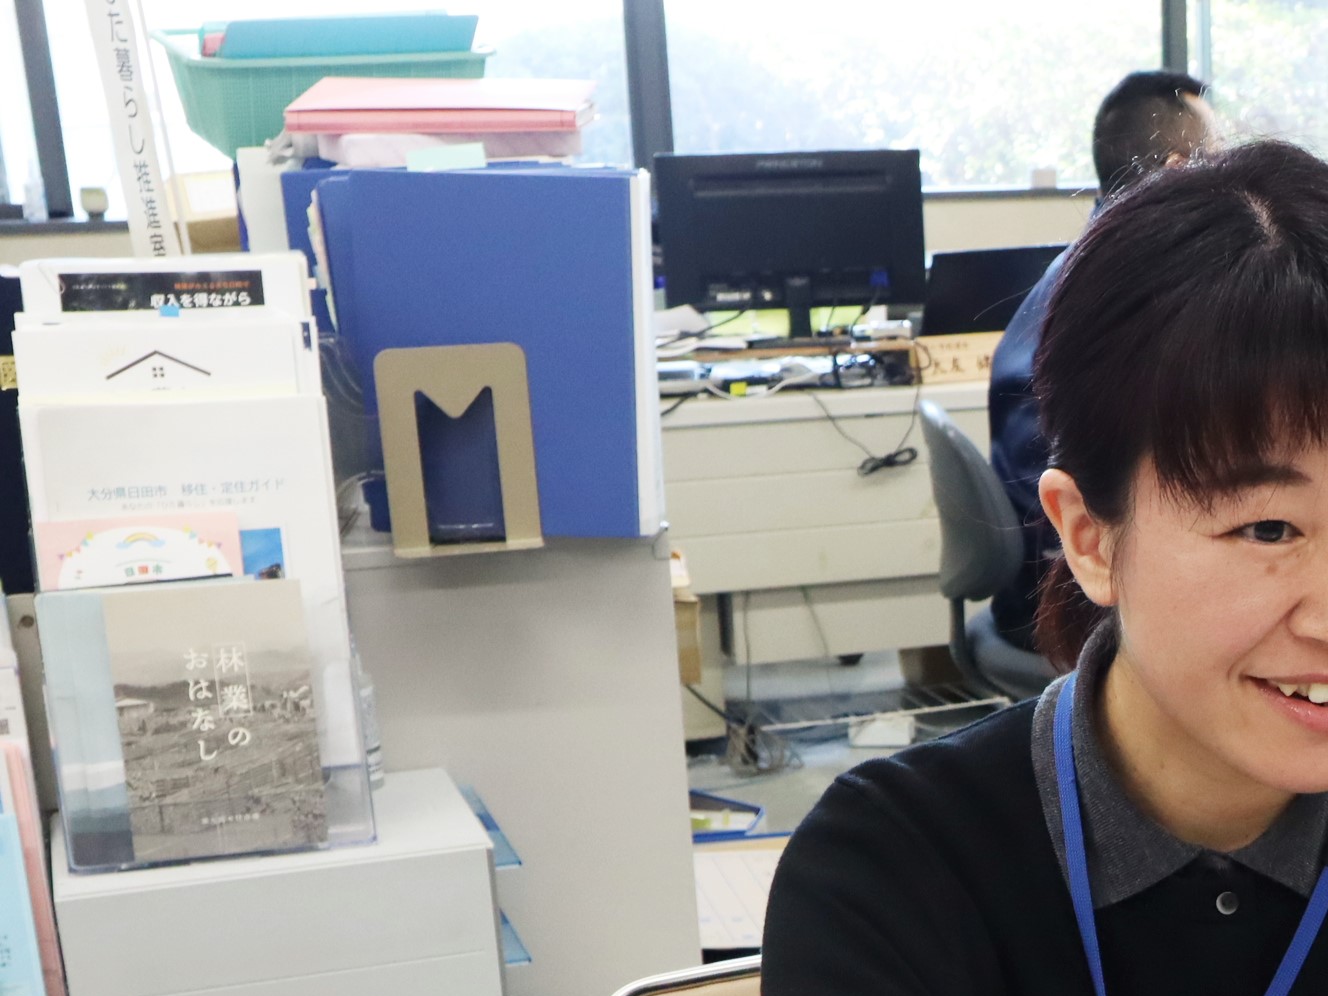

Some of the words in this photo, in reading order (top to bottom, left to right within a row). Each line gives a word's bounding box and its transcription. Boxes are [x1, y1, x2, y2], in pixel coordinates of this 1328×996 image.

[87, 485, 168, 502] 大分県日田市
[183, 648, 218, 761] おはなし
[215, 646, 251, 746] 林業の
